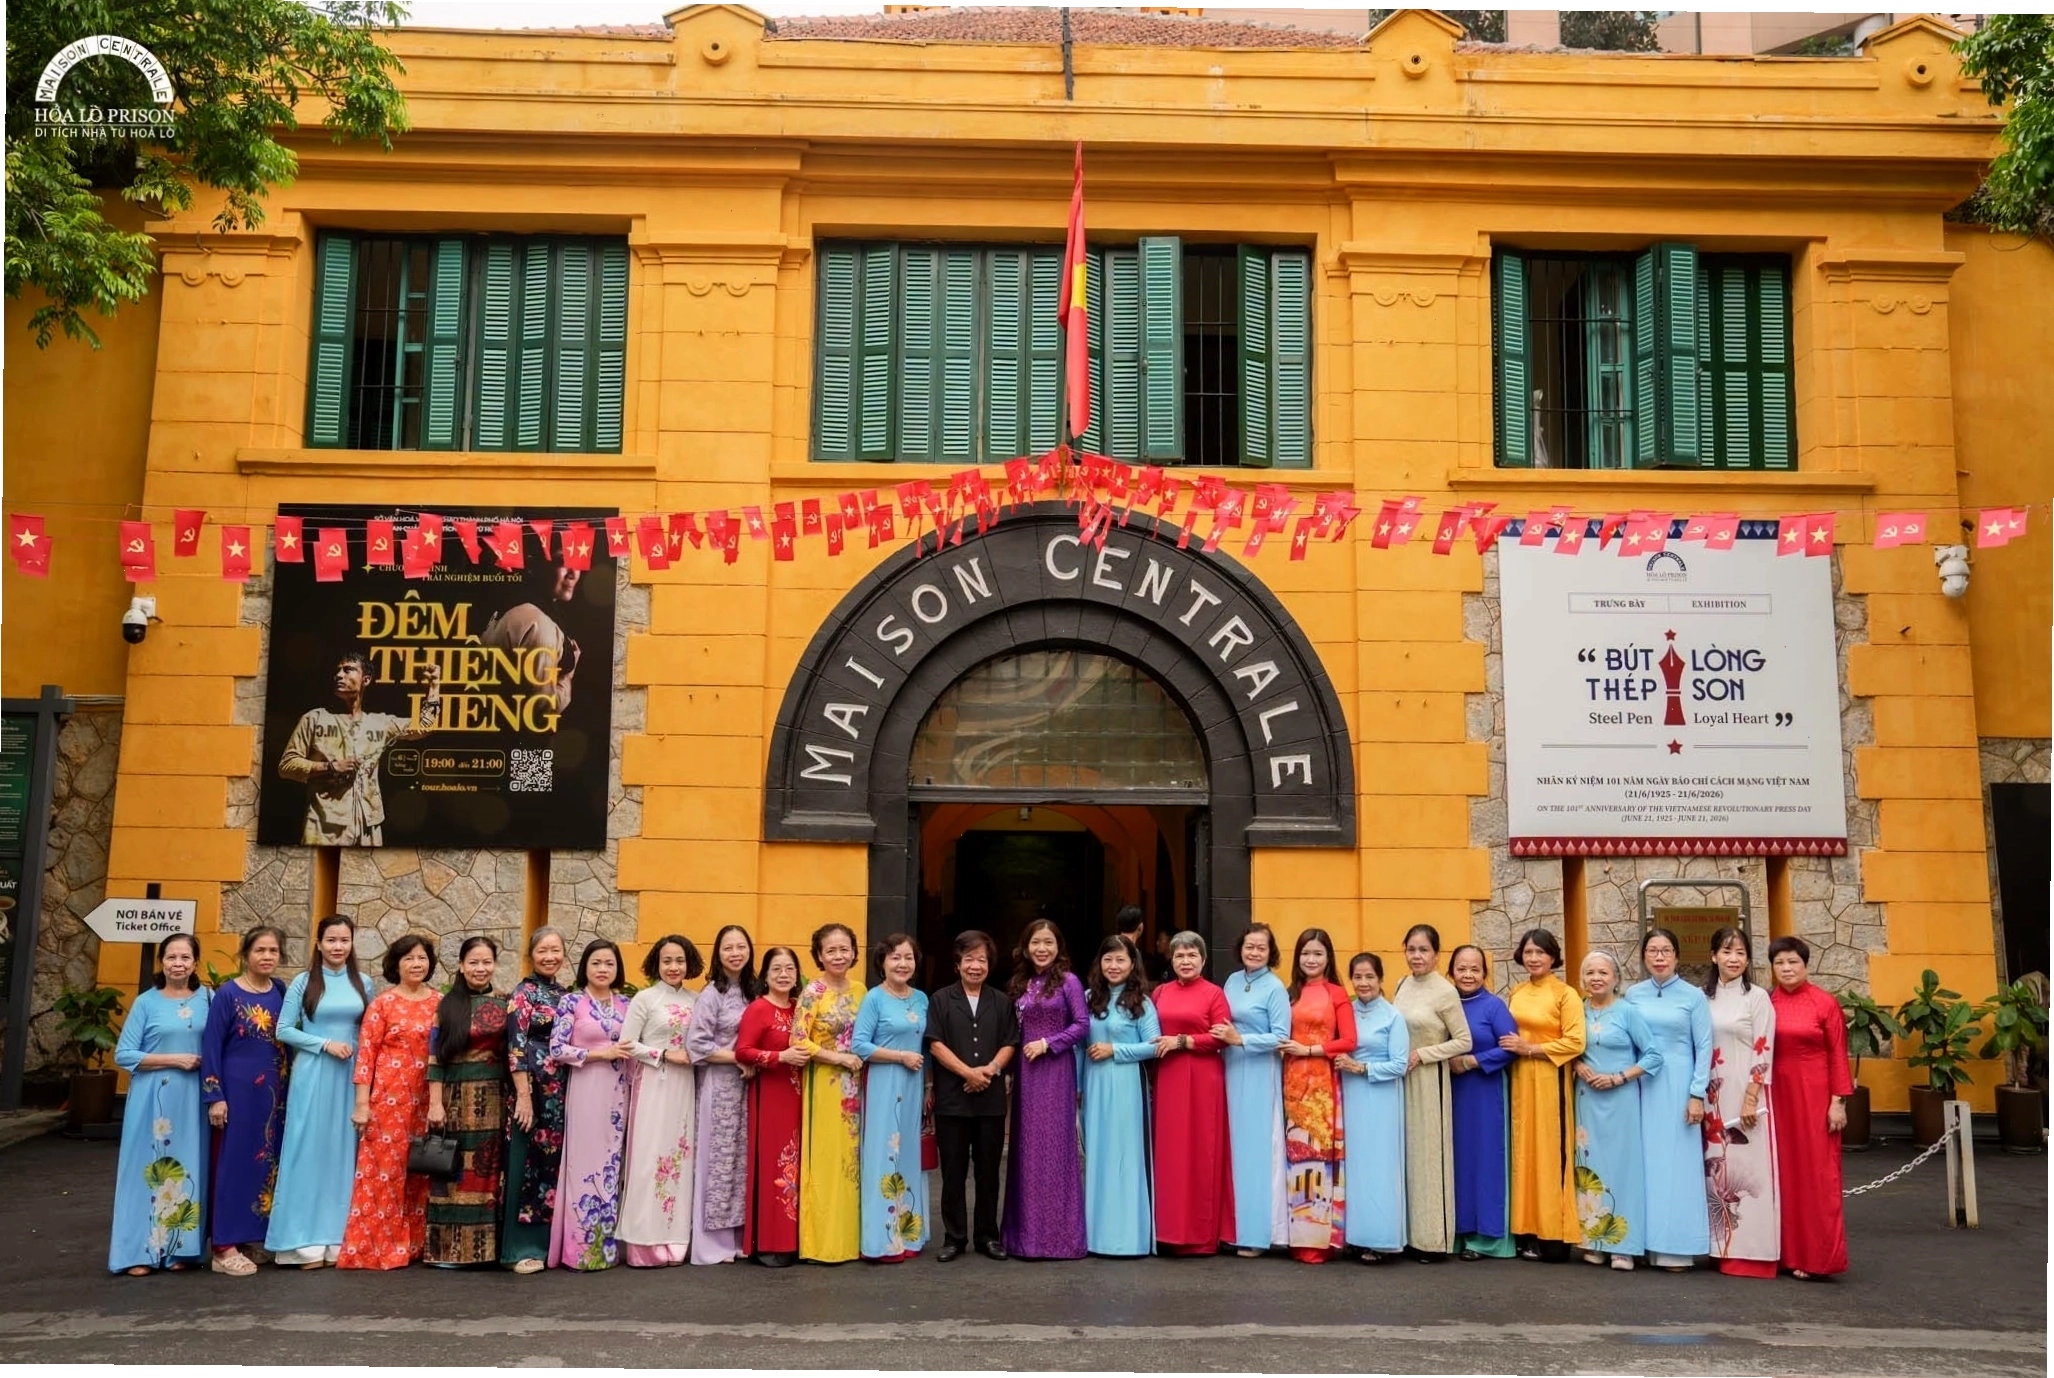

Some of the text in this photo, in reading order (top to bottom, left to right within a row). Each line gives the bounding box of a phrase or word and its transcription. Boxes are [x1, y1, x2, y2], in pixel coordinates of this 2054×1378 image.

[1628, 598, 1646, 608] BÀY
[1692, 600, 1747, 608] EXHIBITION
[356, 589, 472, 640] ĐÊM
[369, 635, 562, 686] THIÊNG
[799, 533, 1313, 789] MAISON CENTRALE
[1605, 643, 1654, 671] BÚT
[1691, 643, 1767, 672] LÒNG
[1585, 673, 1657, 701] THÉP
[1691, 678, 1745, 702] SON
[406, 682, 562, 733] LIÊNG
[1588, 711, 1653, 725] Steel Pen
[1693, 711, 1729, 728] Loyal
[1732, 711, 1770, 725] Heart
[424, 758, 456, 768] 19:00
[471, 758, 503, 769] 21:00
[421, 783, 478, 792] tour.hoalo.vn
[1579, 775, 1604, 787] NIỆM
[1606, 777, 1621, 785] 101
[1646, 776, 1670, 785] NGÀY
[1710, 776, 1735, 786] CÁCH
[1736, 777, 1765, 787] MẠNG
[1765, 776, 1787, 787] VIỆT
[1788, 778, 1810, 786] NAM
[1624, 790, 1671, 800] (21/6/1925
[1677, 790, 1724, 799] 21/6/2026)
[1585, 805, 1636, 813] ANNIVERSARY
[1665, 805, 1712, 813] VIETNAMESE
[1713, 805, 1774, 813] REVOLUTIONARY
[1774, 805, 1797, 813] PRESS
[1797, 805, 1813, 813] DAY
[1621, 814, 1641, 823] (JUNE
[1656, 814, 1672, 822] 1925
[1677, 814, 1697, 823] JUNE
[1709, 814, 1729, 823] 2026)
[116, 909, 138, 919] NƠI
[140, 908, 166, 920] BÁN
[115, 921, 181, 932] Ticket Office
